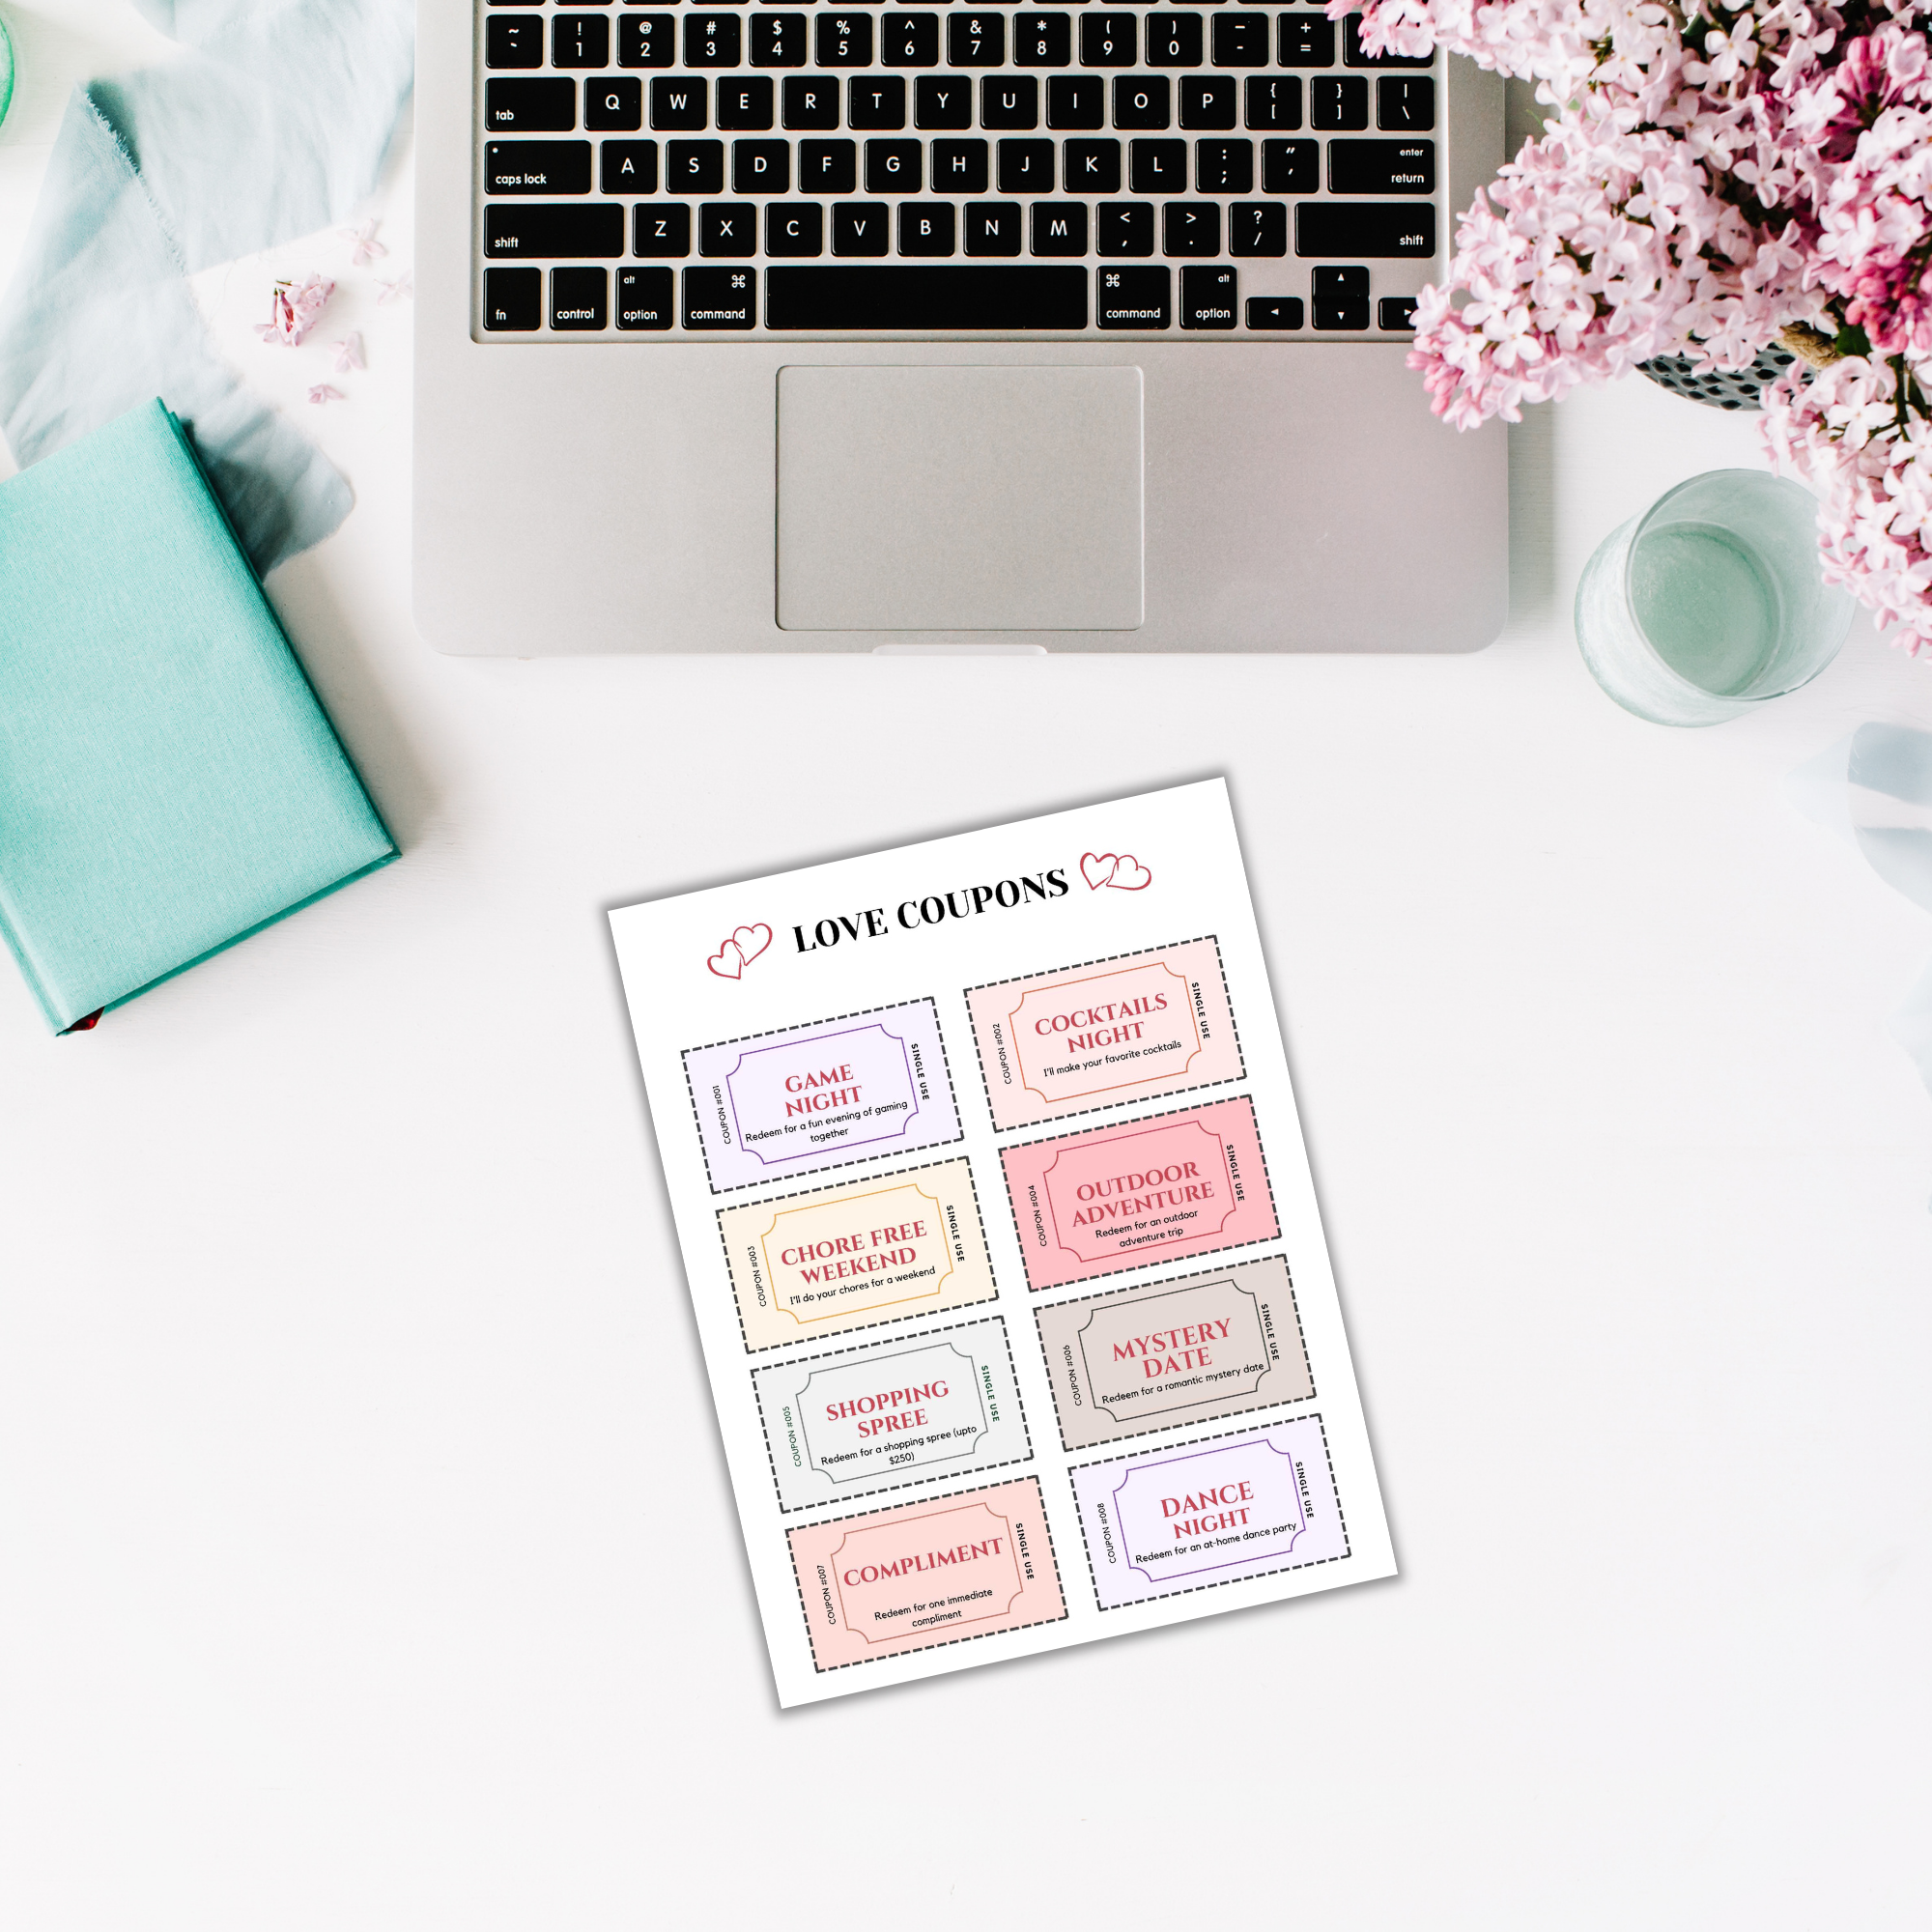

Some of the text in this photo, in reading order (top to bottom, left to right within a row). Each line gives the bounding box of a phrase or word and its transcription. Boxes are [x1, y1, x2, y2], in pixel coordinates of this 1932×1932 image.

[576, 42, 582, 57] 1
[640, 42, 651, 57] 2
[705, 42, 717, 57] 3
[772, 41, 783, 56] 4
[838, 41, 848, 56] 5
[904, 41, 915, 56] 6
[970, 40, 981, 55] 7
[1037, 41, 1047, 56] 8
[1102, 41, 1114, 56] 9
[1168, 41, 1179, 56] 0
[605, 94, 620, 110] Q
[669, 94, 688, 110] W
[739, 93, 750, 109] E
[805, 93, 816, 109] R
[871, 93, 883, 109] T
[937, 93, 949, 109] Y
[1003, 93, 1016, 109] U
[1134, 93, 1149, 109] O
[1203, 93, 1214, 109] P
[496, 109, 515, 121] tab
[1399, 148, 1424, 156] enter
[621, 157, 635, 174] A
[689, 157, 699, 173] S
[754, 156, 767, 173] D
[822, 156, 832, 172] F
[886, 156, 900, 172] G
[952, 156, 966, 172] H
[1020, 156, 1030, 172] J
[1086, 156, 1098, 172] K
[1153, 156, 1163, 172] L
[495, 173, 547, 186] caps lock
[1391, 173, 1425, 184] return
[654, 220, 667, 237] Z
[720, 220, 733, 237] X
[786, 220, 800, 237] C
[853, 220, 867, 237] V
[920, 219, 931, 235] B
[985, 219, 999, 236] N
[1050, 219, 1067, 236] M
[495, 236, 519, 248] shift
[1399, 234, 1424, 245] shift
[623, 275, 636, 284] alt
[1217, 273, 1230, 283] alt
[496, 308, 506, 321] fn
[556, 307, 595, 320] control
[623, 309, 658, 322] option
[690, 307, 746, 320] command
[1105, 307, 1161, 319] command
[1195, 307, 1231, 321] option
[791, 867, 1069, 953] LOVE COUPONS
[1035, 992, 1168, 1036] COCKTAILS
[1191, 981, 1210, 1039] SINGLE USE
[1067, 1020, 1145, 1054] NIGHT
[992, 1023, 1012, 1085] COUPON #002
[1056, 1063, 1081, 1075] make
[1082, 1059, 1103, 1071] your
[1104, 1050, 1141, 1064] favorite
[1142, 1039, 1182, 1056] cocktails
[784, 1064, 854, 1093] GAME
[911, 1043, 930, 1100] SINGLE USE
[784, 1085, 863, 1118] NIGHT
[712, 1085, 731, 1145] COUPON #001
[745, 1128, 782, 1143] Redeem
[783, 1124, 798, 1134] for
[808, 1120, 824, 1128] fun
[825, 1111, 862, 1125] evening
[863, 1106, 872, 1117] of
[874, 1101, 908, 1116] gaming
[810, 1127, 849, 1143] together
[1076, 1161, 1201, 1202] OUTDOOR
[1226, 1144, 1245, 1202] SINGLE USE
[1072, 1180, 1215, 1228] ADVENTURE
[1027, 1184, 1047, 1247] COUPON #004
[1094, 1210, 1198, 1238] Redeem for an outdoor
[781, 1220, 927, 1265] CHORE FREE
[946, 1205, 965, 1263] SINGLE USE
[1119, 1227, 1184, 1248] adventure trip
[800, 1247, 917, 1285] WEEKEND
[747, 1245, 767, 1307] COUPON #003
[803, 1293, 815, 1302] do
[816, 1289, 837, 1301] your
[838, 1282, 869, 1294] chores
[870, 1278, 884, 1288] for
[894, 1265, 936, 1282] weekend
[1113, 1318, 1231, 1362] MYSTERY
[1261, 1303, 1280, 1361] SINGLE USE
[1142, 1346, 1212, 1378] DATE
[1063, 1345, 1082, 1406] COUPON #006
[1101, 1390, 1140, 1405] Redeem
[1140, 1386, 1154, 1396] for
[1164, 1376, 1204, 1391] romantic
[1205, 1368, 1241, 1382] mystery
[1242, 1363, 1264, 1374] date
[826, 1380, 950, 1421] SHOPPING
[980, 1365, 1000, 1423] SINGLE USE
[857, 1407, 928, 1438] SPREE
[781, 1406, 802, 1467] COUPON #005
[820, 1452, 859, 1465] Redeem
[860, 1447, 873, 1457] for
[883, 1437, 924, 1452] shopping
[925, 1432, 952, 1444] spree
[952, 1426, 978, 1438] (upto
[889, 1451, 915, 1465] $250)
[1295, 1461, 1315, 1519] SINGLE USE
[1160, 1480, 1254, 1519] DANCE
[1173, 1507, 1250, 1540] NIGHT
[1096, 1502, 1117, 1564] COUPON #008
[1015, 1522, 1035, 1580] SINGLE USE
[1135, 1522, 1297, 1564] Redeem for an at-home dance party
[843, 1537, 1003, 1586] COMPLIMENT
[816, 1565, 837, 1625] COUPON #007
[874, 1589, 993, 1621] Redeem for one immediate
[912, 1609, 962, 1628] compliment
